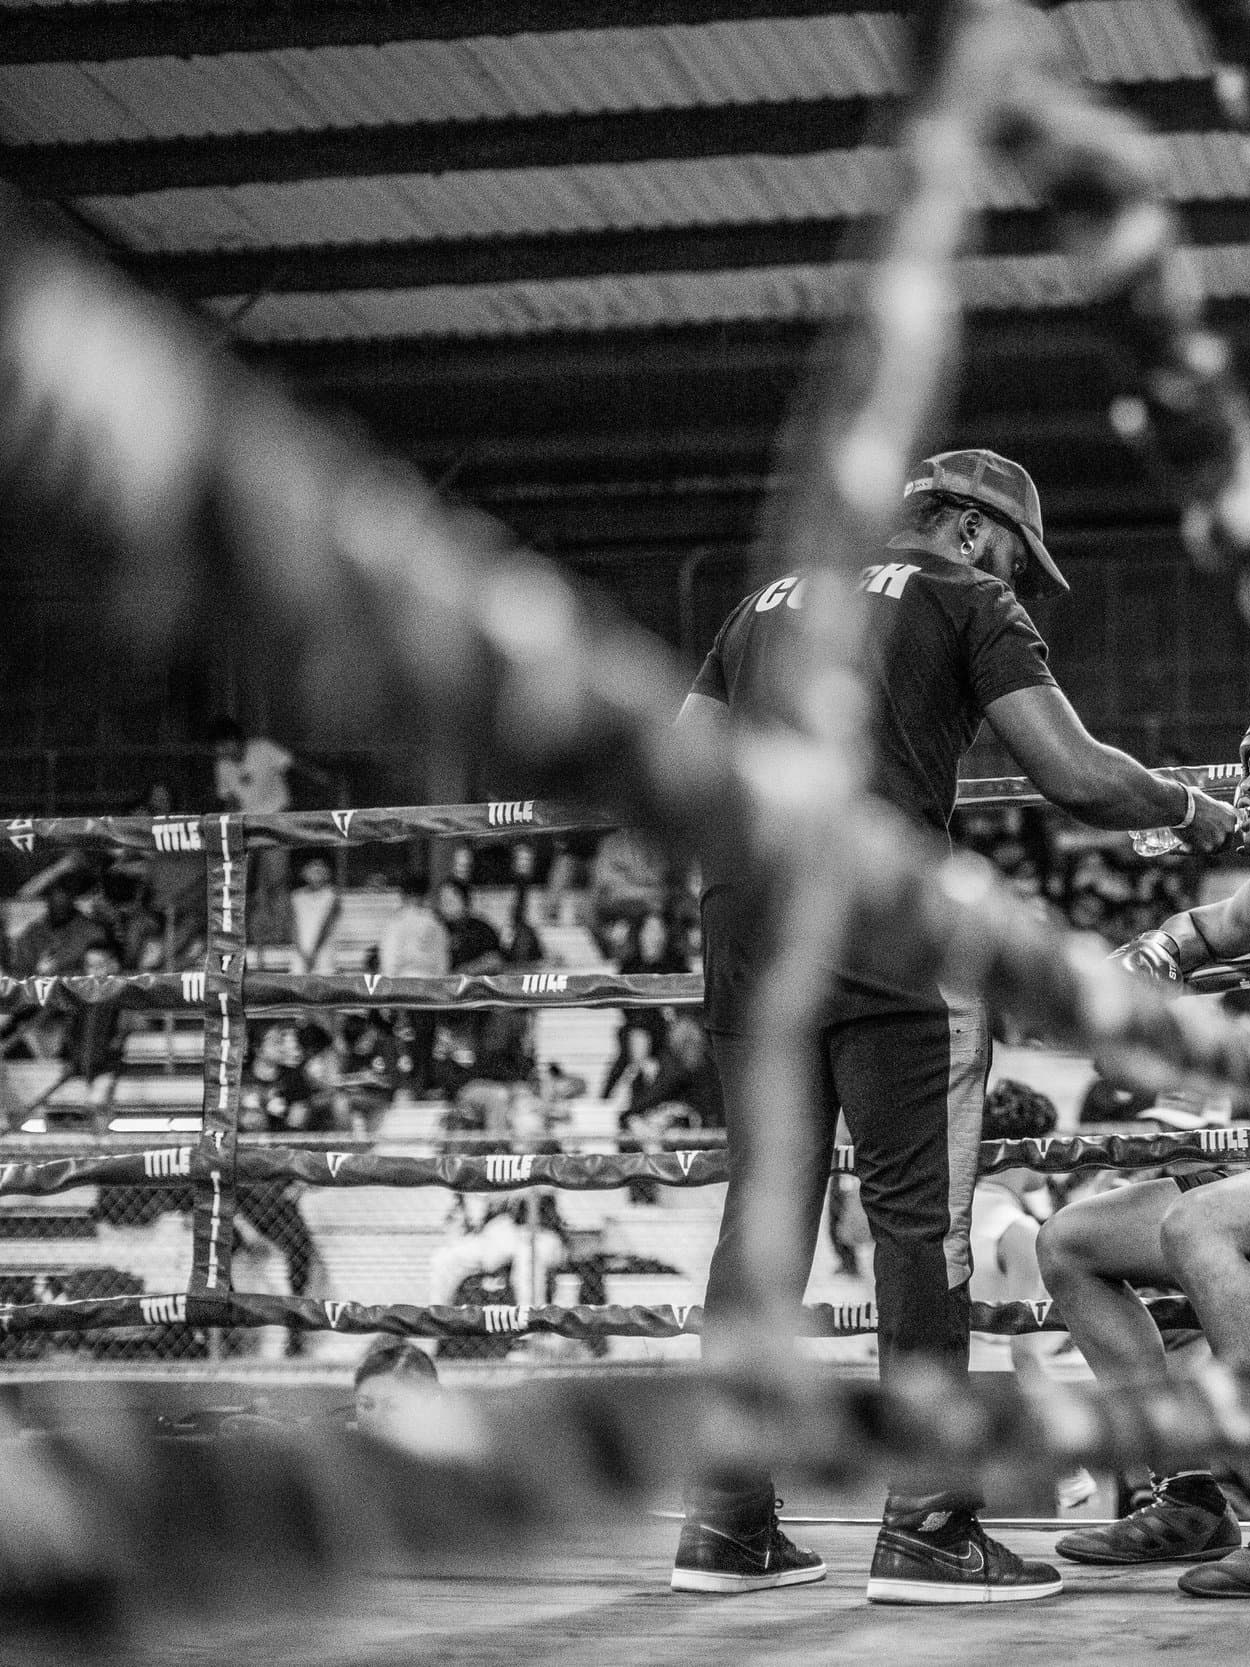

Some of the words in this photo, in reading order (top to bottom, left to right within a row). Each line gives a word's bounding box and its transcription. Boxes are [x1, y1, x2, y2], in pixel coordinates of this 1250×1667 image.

[755, 563, 922, 612] CCH
[489, 800, 535, 826] TITLE
[152, 821, 201, 852] TITLE
[1199, 1128, 1249, 1154] TITLE
[143, 1146, 193, 1178] TITLE
[486, 1153, 537, 1184] TITLE
[139, 1294, 187, 1324] TITLE
[482, 1303, 531, 1334] TITLE
